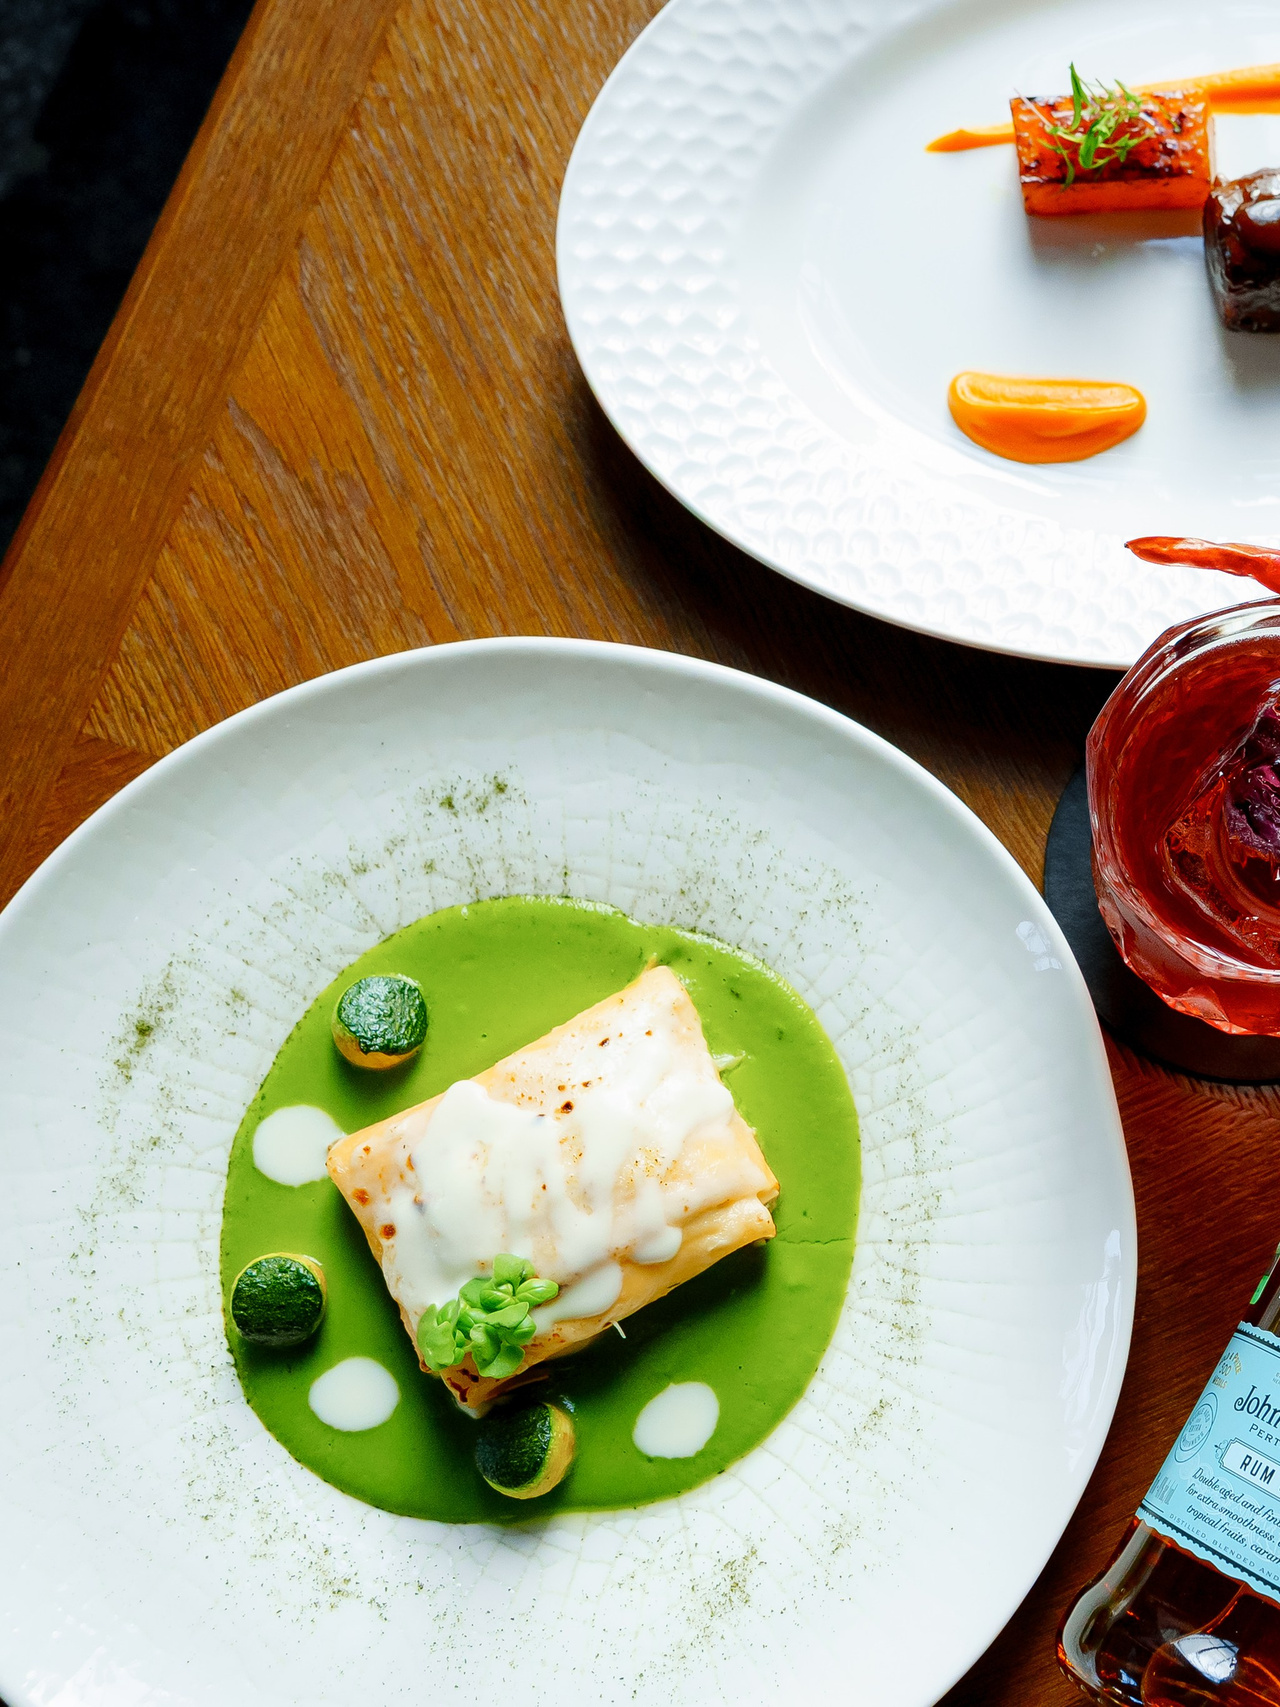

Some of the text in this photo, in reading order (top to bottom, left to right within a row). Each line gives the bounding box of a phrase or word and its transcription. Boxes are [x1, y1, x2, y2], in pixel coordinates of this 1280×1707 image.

[1240, 1454, 1276, 1484] RUM
[1192, 1467, 1220, 1490] Double
[1219, 1488, 1244, 1503] aged
[1241, 1500, 1265, 1515] and
[1185, 1483, 1198, 1496] for
[1197, 1494, 1219, 1510] extra
[1218, 1507, 1275, 1543] smoothness.
[1186, 1505, 1222, 1528] tropical
[1218, 1522, 1247, 1547] fruits,
[1212, 1539, 1255, 1567] BLENDED
[1259, 1567, 1279, 1581] AND
